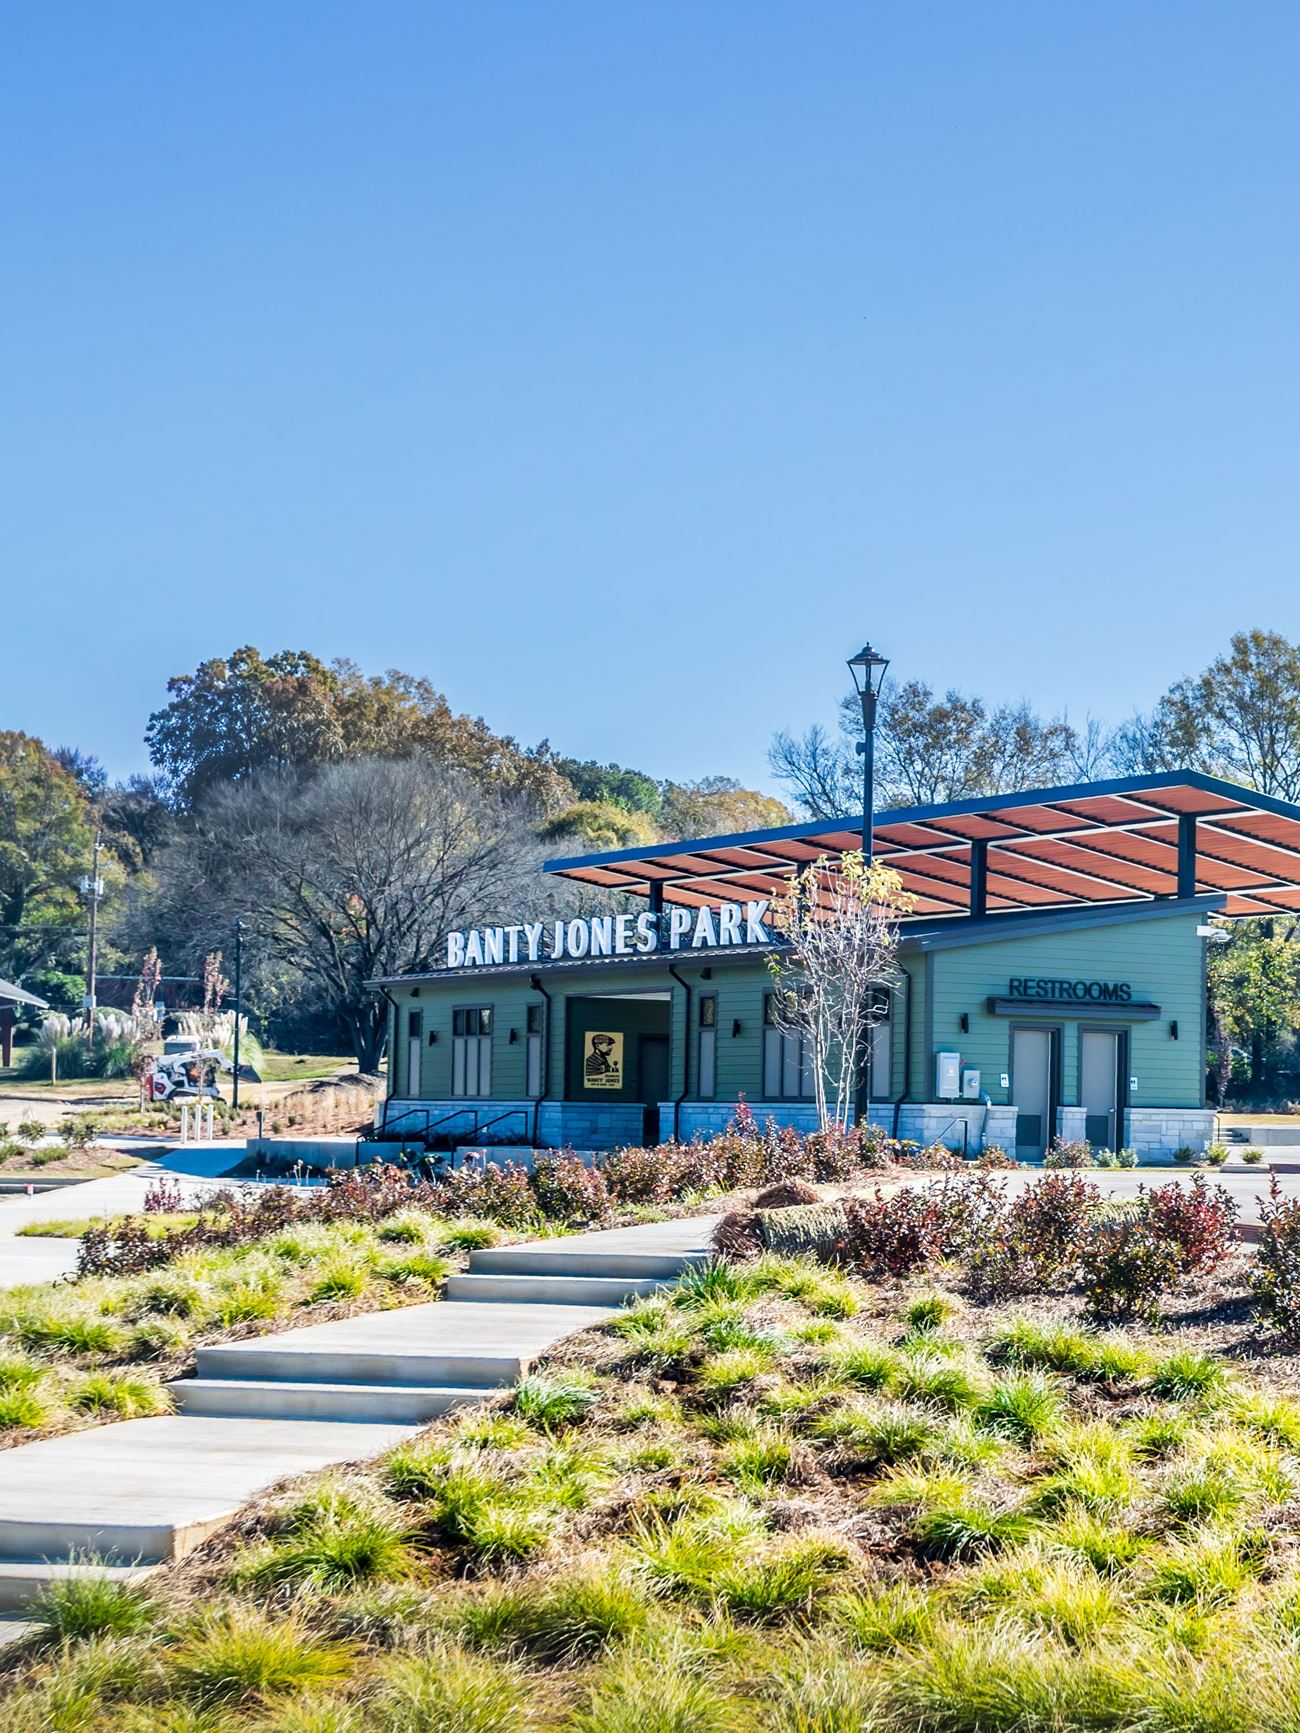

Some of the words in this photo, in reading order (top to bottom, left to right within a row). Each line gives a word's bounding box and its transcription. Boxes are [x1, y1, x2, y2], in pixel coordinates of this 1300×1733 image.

[447, 922, 544, 968] BANTY
[551, 911, 658, 959] JONES
[670, 900, 770, 949] PARK
[1009, 977, 1132, 1001] RESTROOMS
